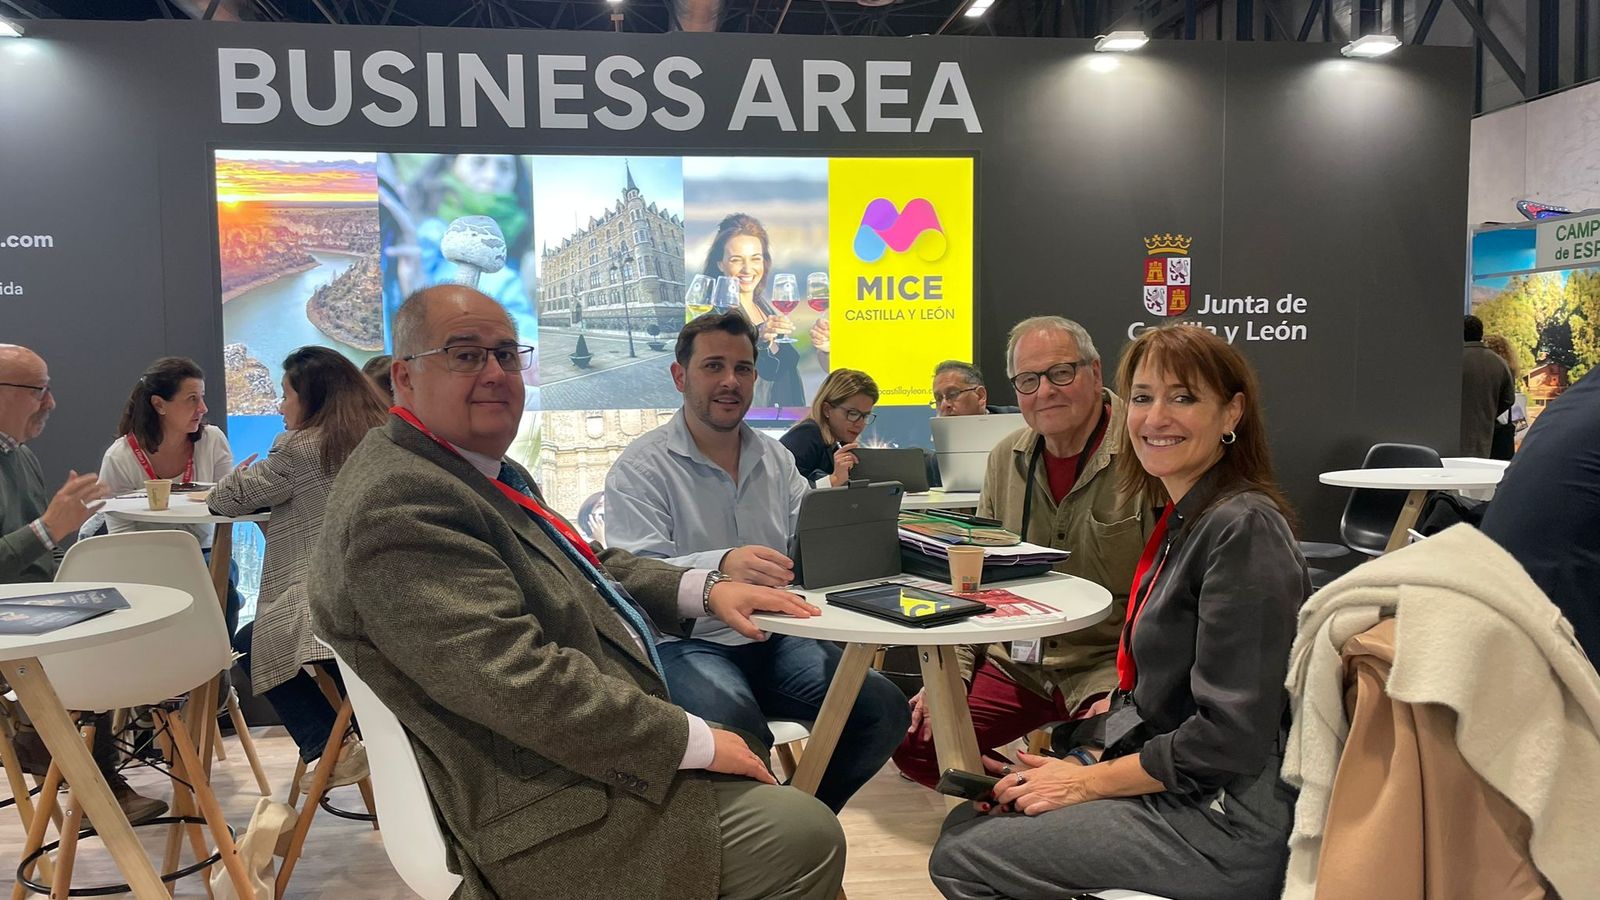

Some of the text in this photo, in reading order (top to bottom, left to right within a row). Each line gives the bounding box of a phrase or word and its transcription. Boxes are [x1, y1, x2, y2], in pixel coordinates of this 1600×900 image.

[217, 47, 983, 134] BUSINESS AREA
[1556, 220, 1600, 241] CAMP
[1555, 247, 1570, 260] de
[857, 275, 943, 300] MICE
[845, 305, 955, 321] CASTILLA Y LEÓN
[1197, 294, 1308, 314] Junta de
[1224, 325, 1240, 345] y
[1246, 320, 1307, 341] León
